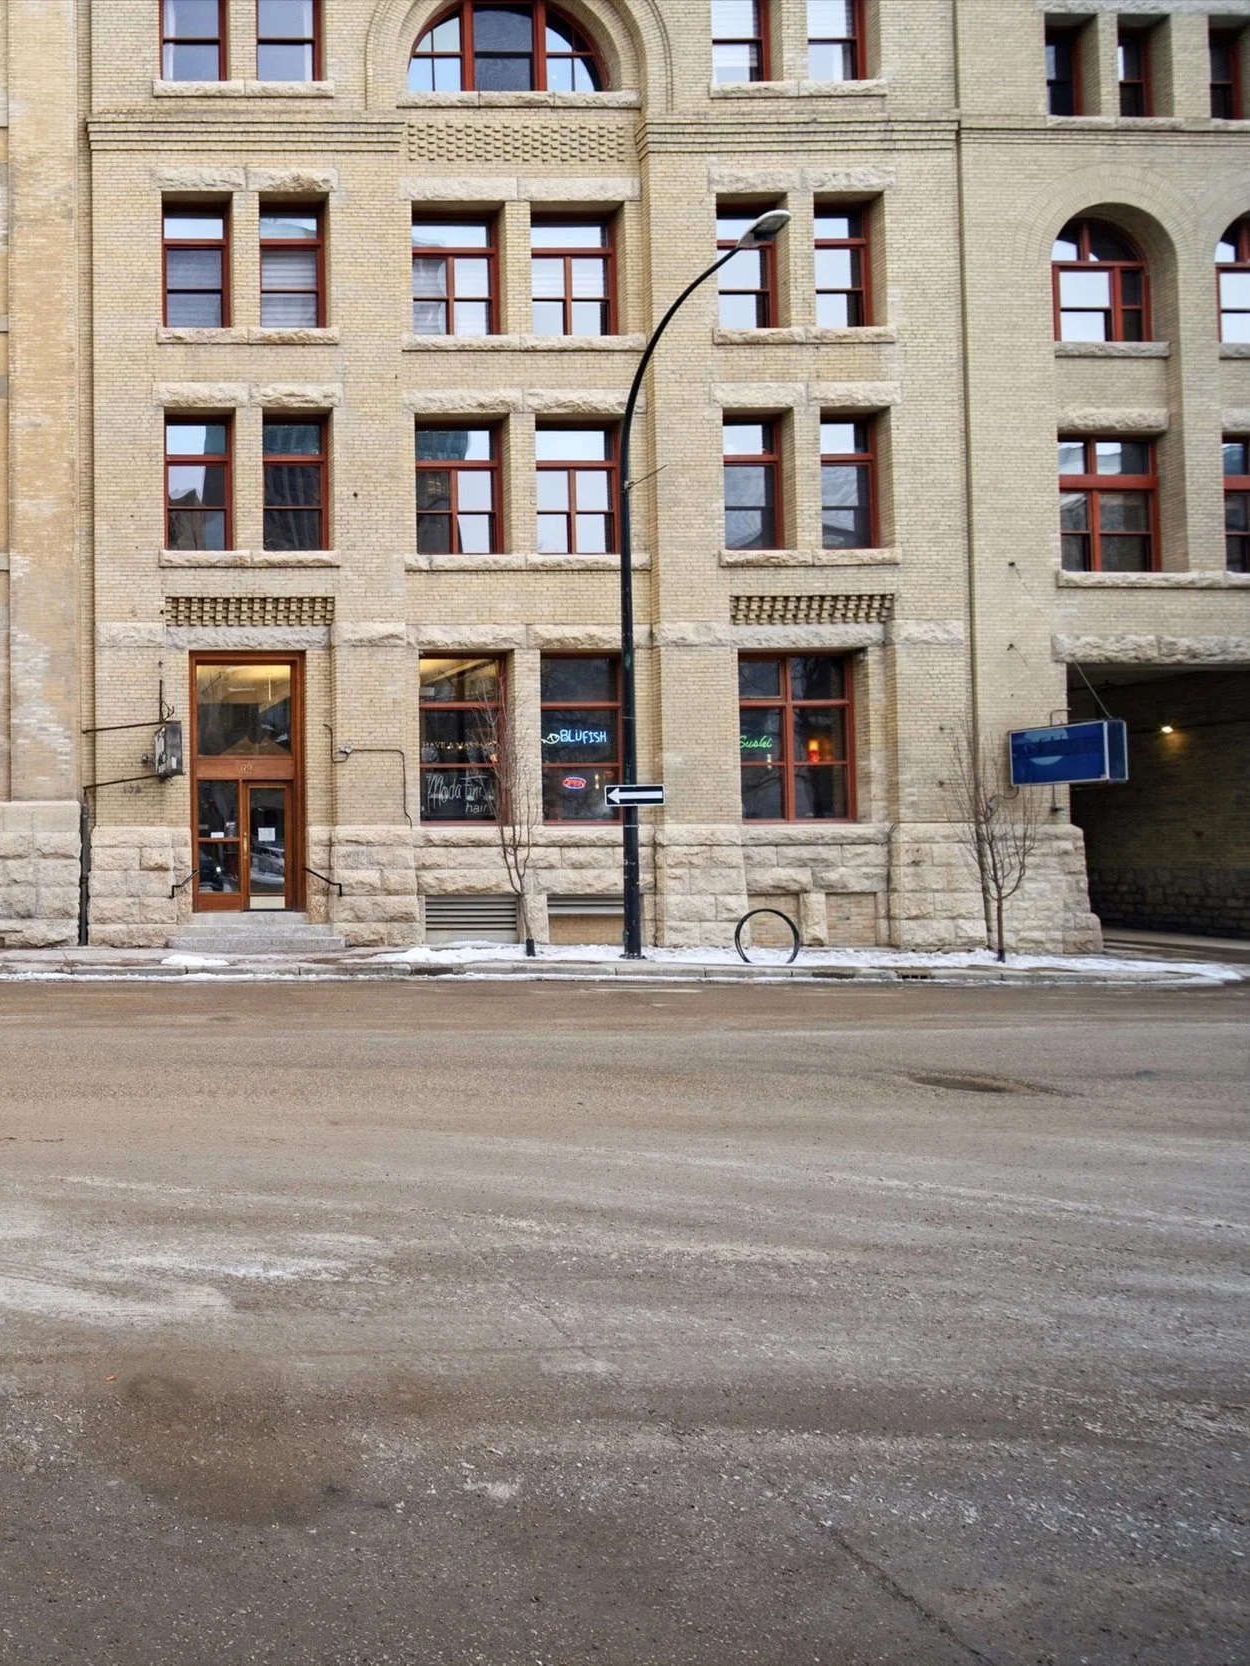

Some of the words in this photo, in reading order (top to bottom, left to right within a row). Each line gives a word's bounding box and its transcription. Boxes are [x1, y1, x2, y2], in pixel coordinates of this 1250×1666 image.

[559, 728, 607, 744] BLUFISH
[739, 734, 773, 749] Sushi
[426, 774, 462, 813] Moda
[465, 802, 488, 814] hair
